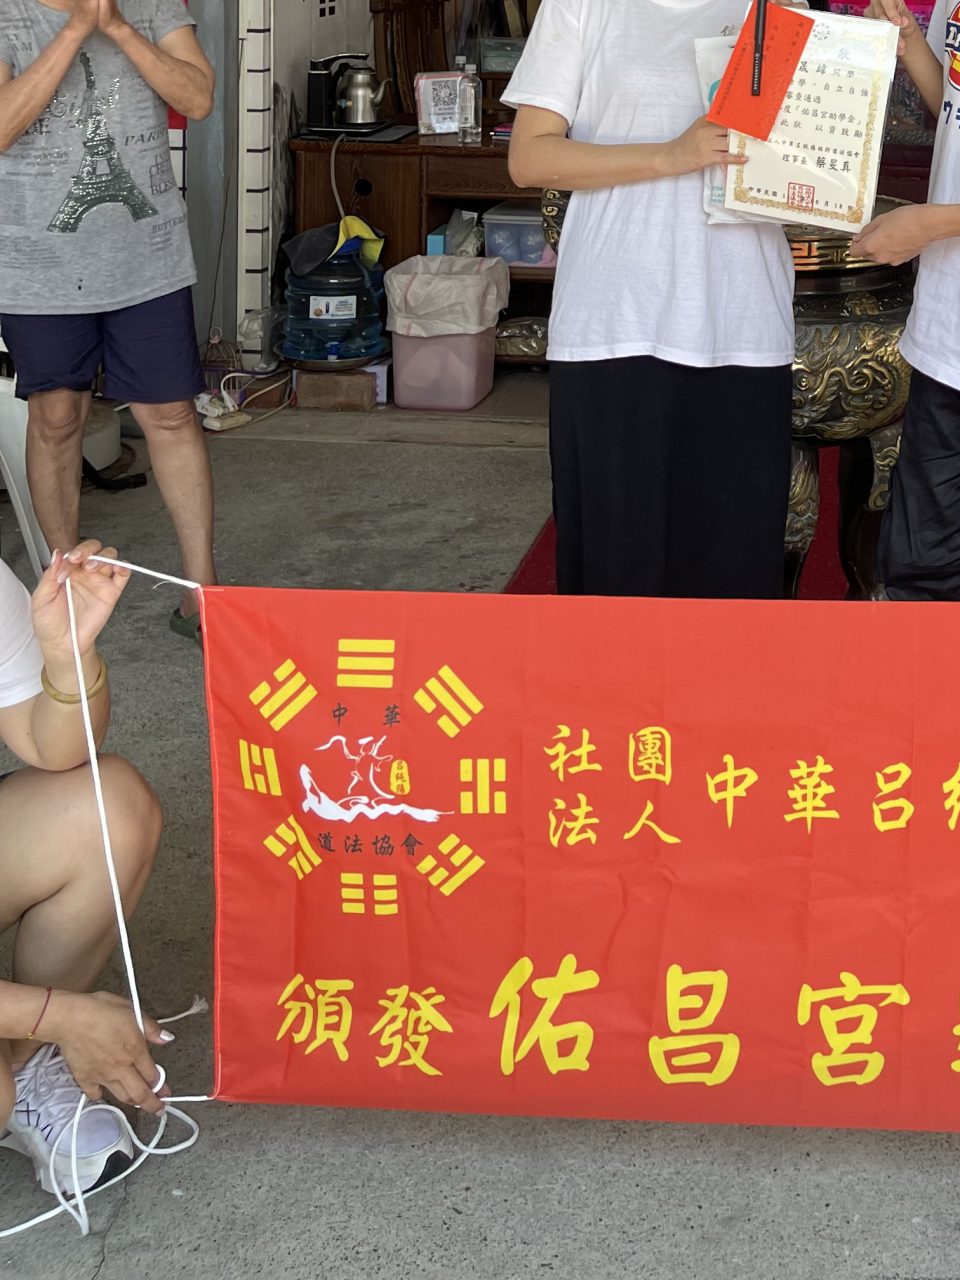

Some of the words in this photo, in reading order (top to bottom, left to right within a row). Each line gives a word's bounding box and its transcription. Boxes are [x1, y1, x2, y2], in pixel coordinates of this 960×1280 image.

[331, 702, 402, 728] 中華
[317, 832, 424, 857] 道法協會
